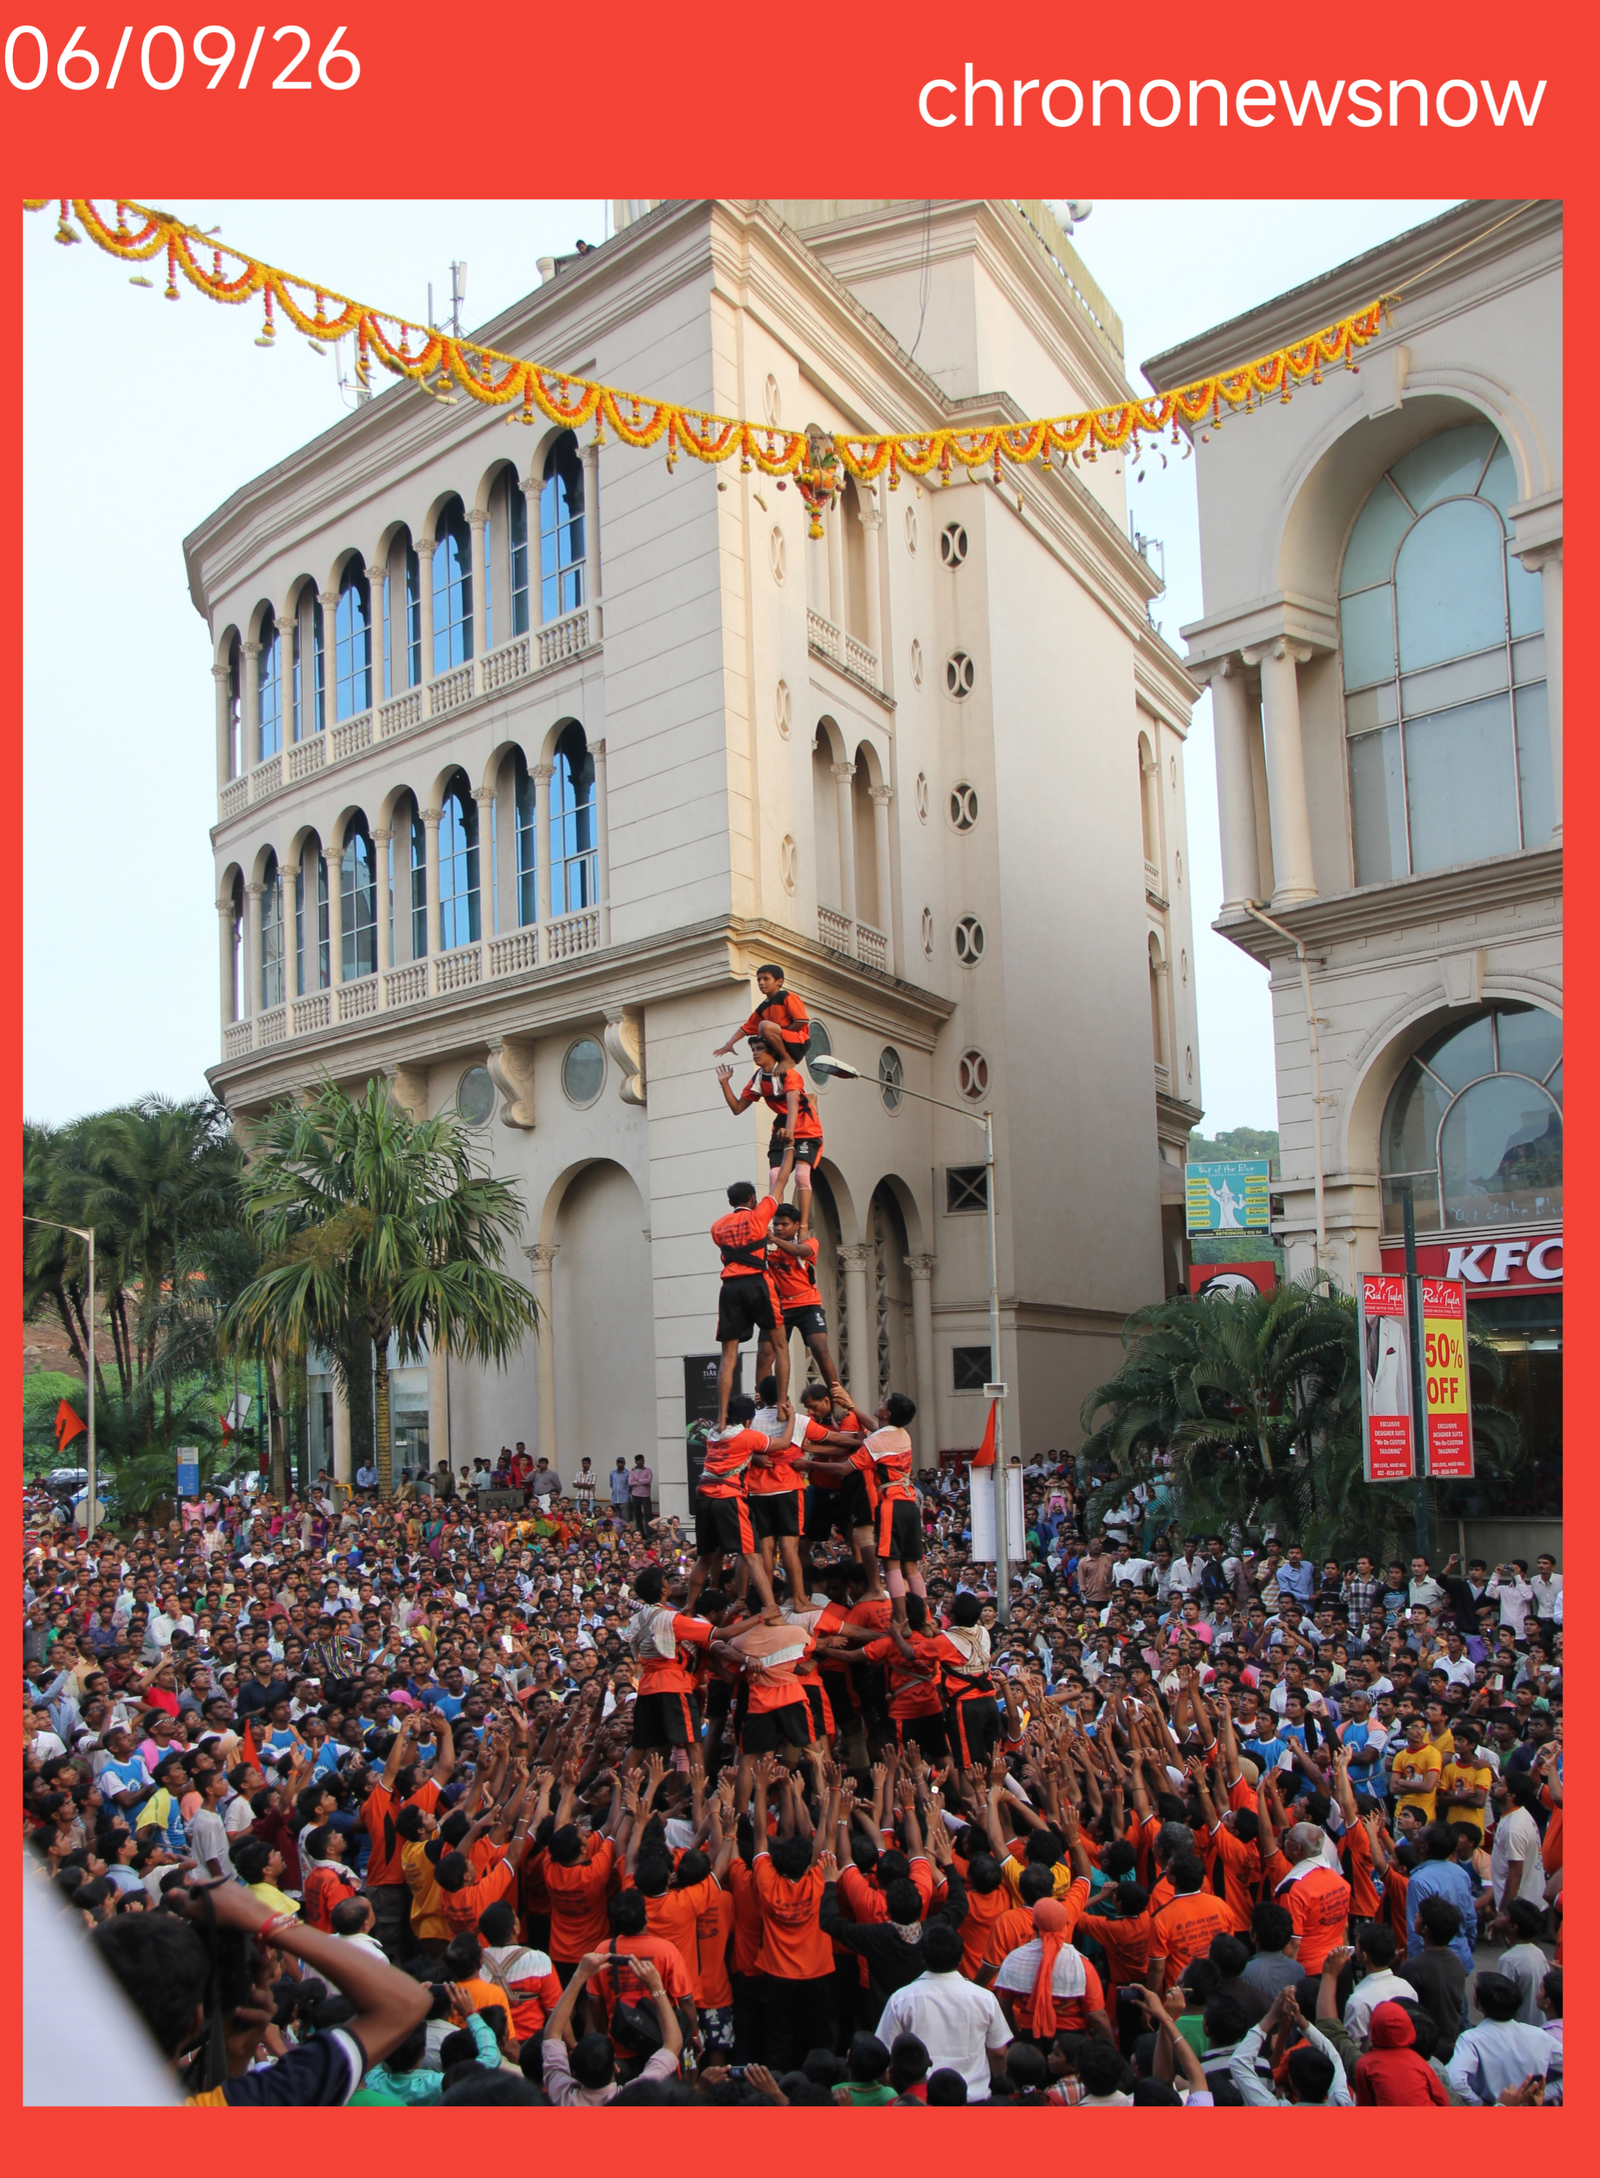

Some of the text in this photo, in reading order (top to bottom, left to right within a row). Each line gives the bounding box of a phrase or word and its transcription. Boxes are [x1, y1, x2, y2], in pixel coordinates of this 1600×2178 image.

[1214, 1165, 1221, 1173] of
[1224, 1164, 1235, 1173] the
[1238, 1163, 1254, 1172] Blue
[1535, 1197, 1563, 1215] Blu
[1446, 1237, 1563, 1284] KFC
[1364, 1284, 1381, 1300] Reid
[1386, 1285, 1403, 1306] Taylor
[1422, 1288, 1438, 1303] Reid
[1443, 1288, 1460, 1310] Taylor
[1426, 1333, 1462, 1368] 50%
[1427, 1377, 1458, 1404] OFF
